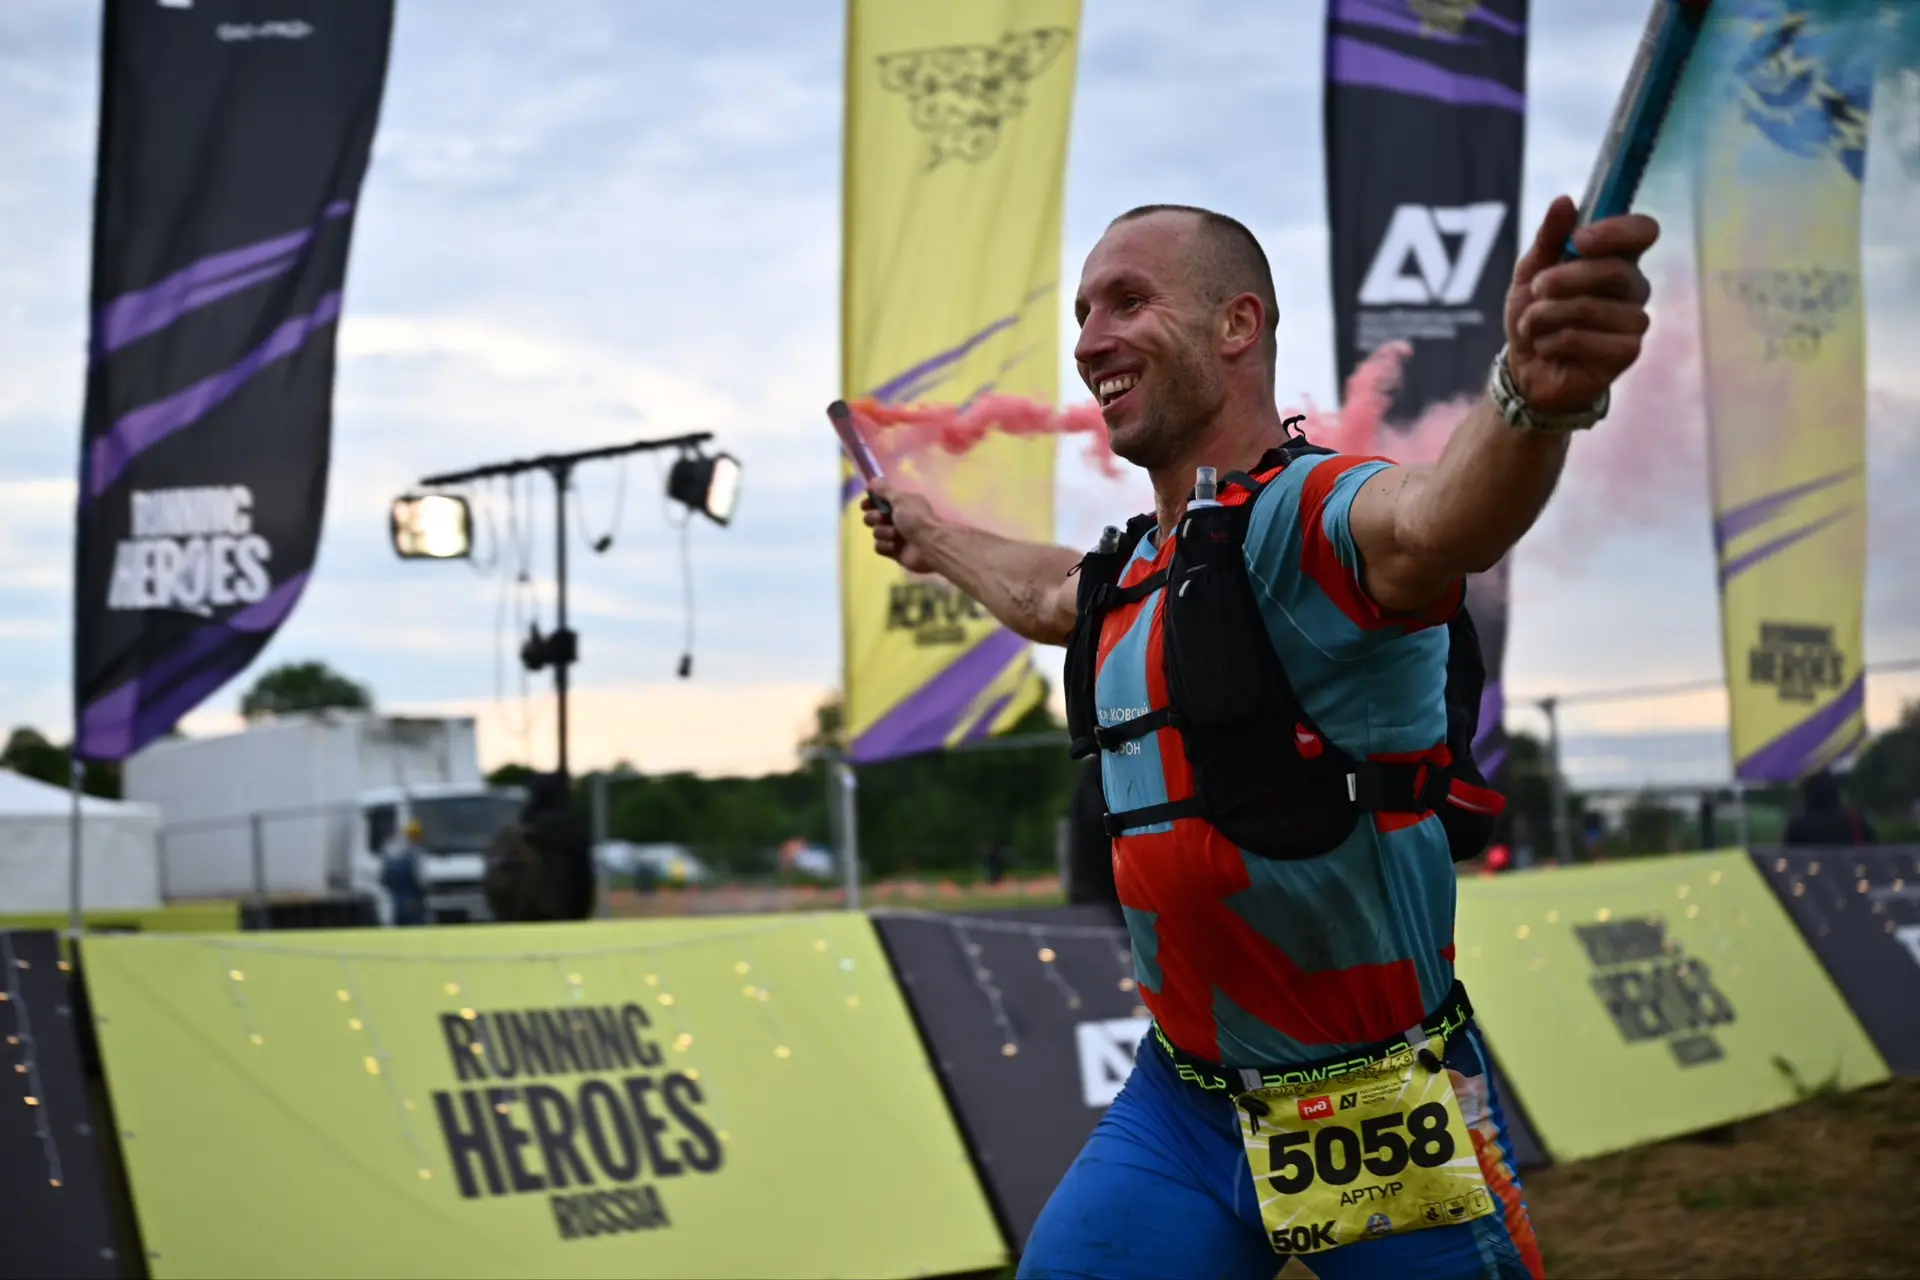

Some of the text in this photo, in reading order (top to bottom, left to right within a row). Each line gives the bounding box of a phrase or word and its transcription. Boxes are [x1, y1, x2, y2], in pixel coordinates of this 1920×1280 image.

[107, 532, 272, 618] HEROES
[439, 1002, 664, 1083] RUNNING
[432, 1071, 725, 1200] HEROES
[1267, 1101, 1456, 1195] 5058
[549, 1183, 673, 1241] RUSSIA
[1339, 1181, 1404, 1207] АРТУР
[1271, 1219, 1339, 1253] 50K
